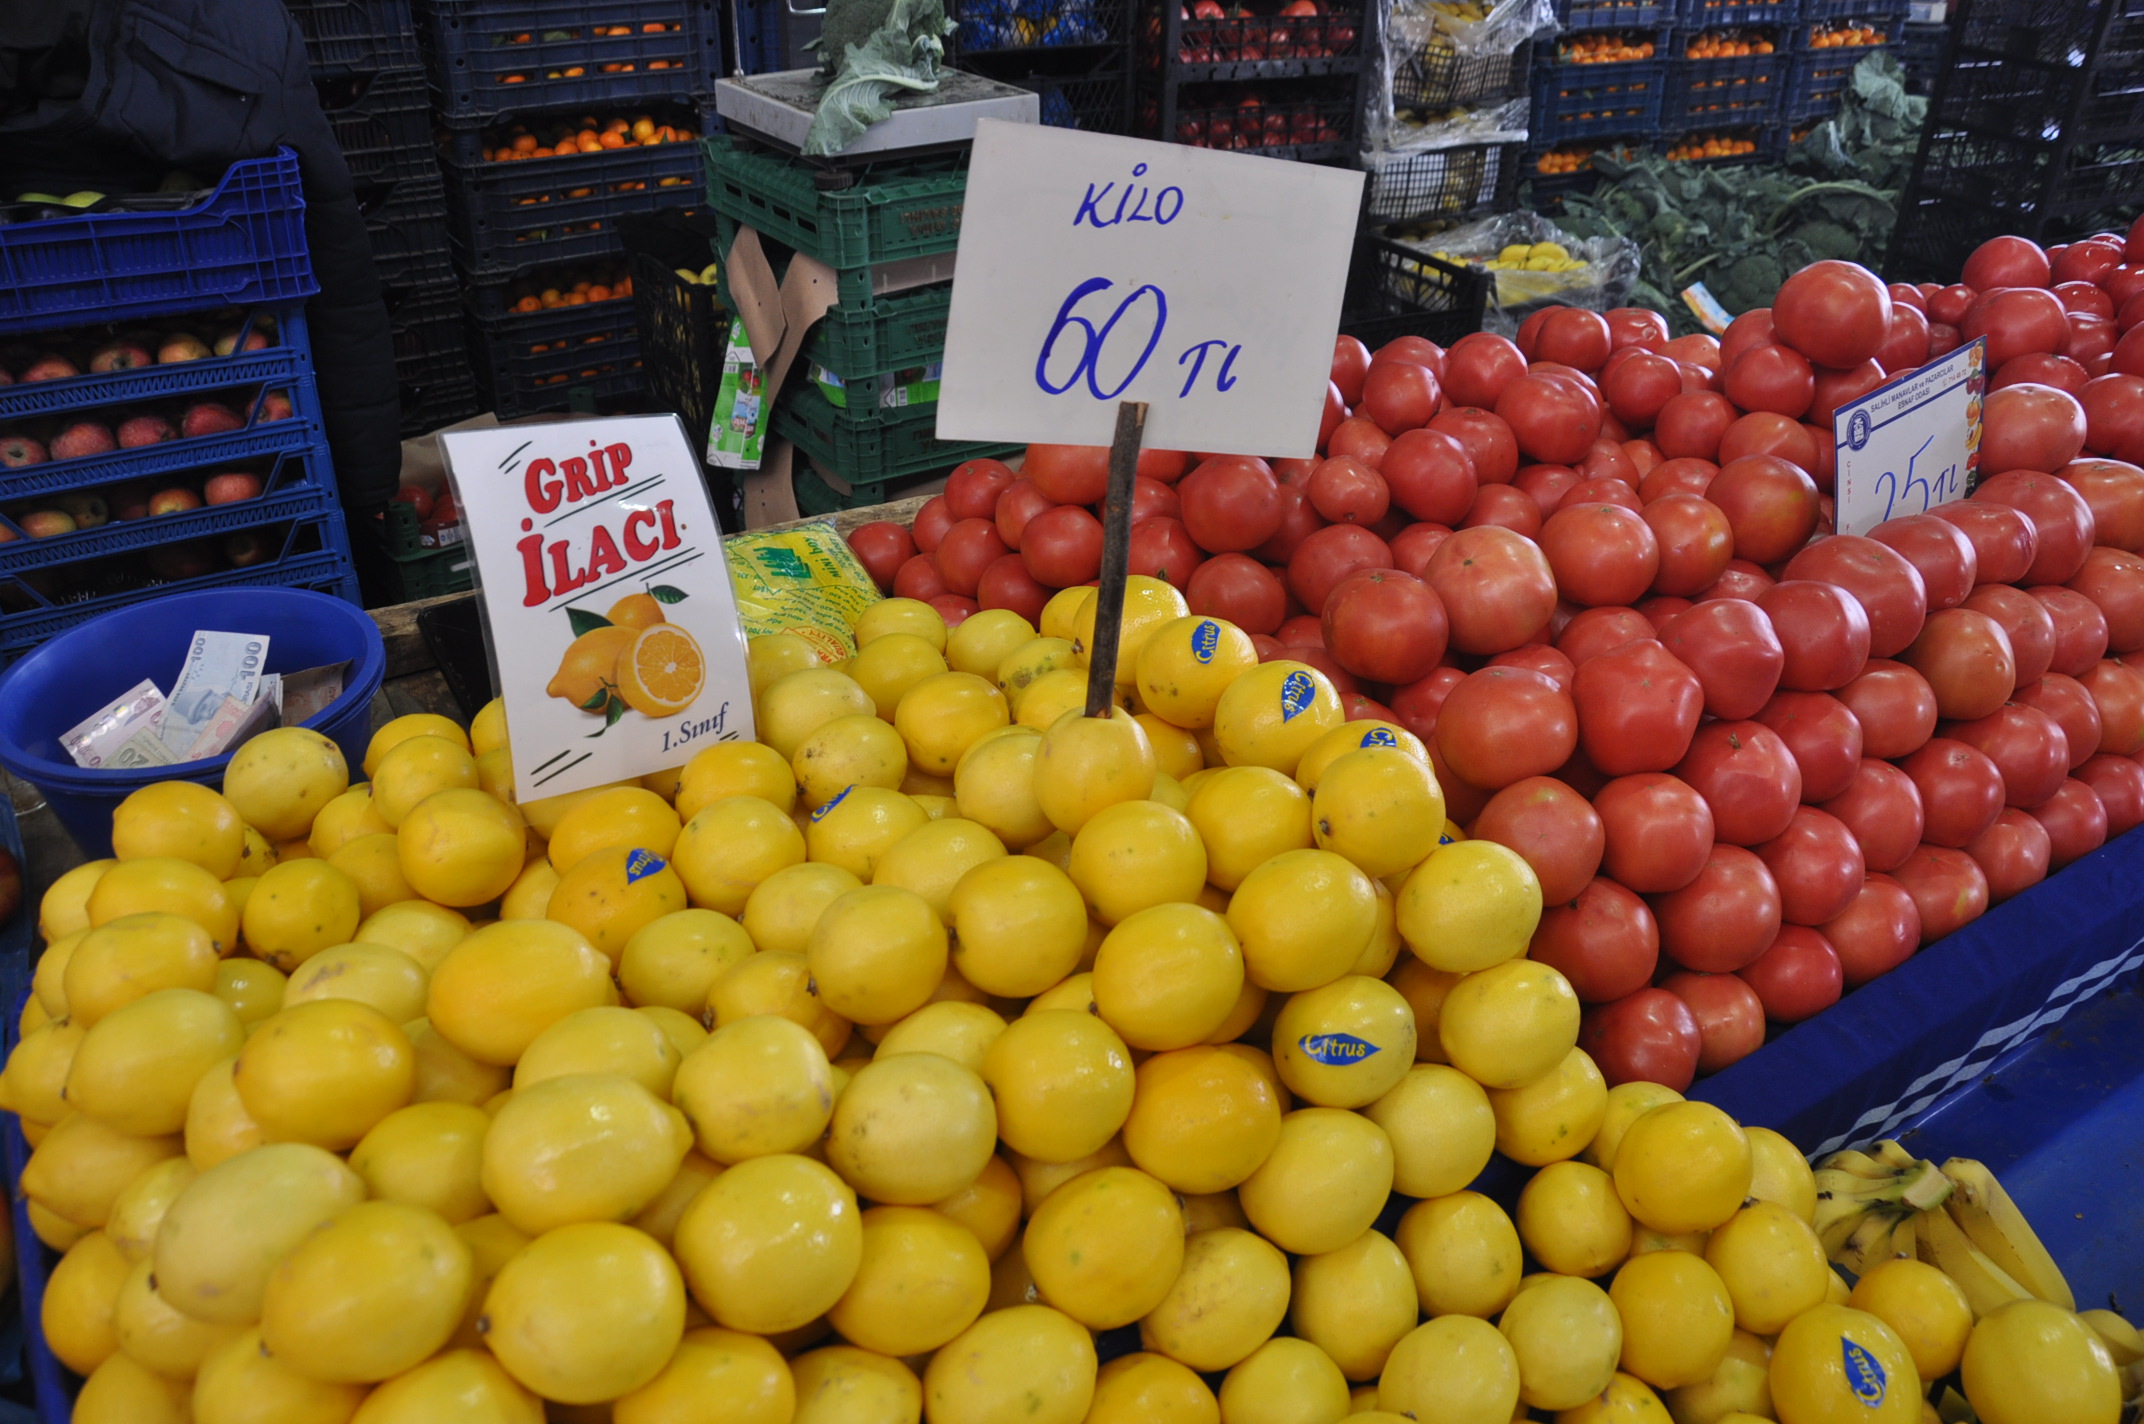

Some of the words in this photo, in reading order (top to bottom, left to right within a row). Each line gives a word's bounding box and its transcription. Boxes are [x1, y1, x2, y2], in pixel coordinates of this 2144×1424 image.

[1035, 276, 1168, 400] 60
[1870, 392, 1891, 413] SALİHLİ
[1891, 382, 1919, 404] MANAVLAR
[1924, 364, 1954, 386] PAZARCILAR
[1897, 395, 1915, 410] ESNAF
[1914, 387, 1931, 402] ODASI
[524, 439, 632, 515] GRİP
[190, 636, 206, 663] 100
[239, 641, 263, 681] 100
[807, 629, 846, 657] QUALITY
[1195, 624, 1216, 663] Citrus
[1283, 671, 1315, 713] Citrus
[1304, 1033, 1367, 1057] Citrus
